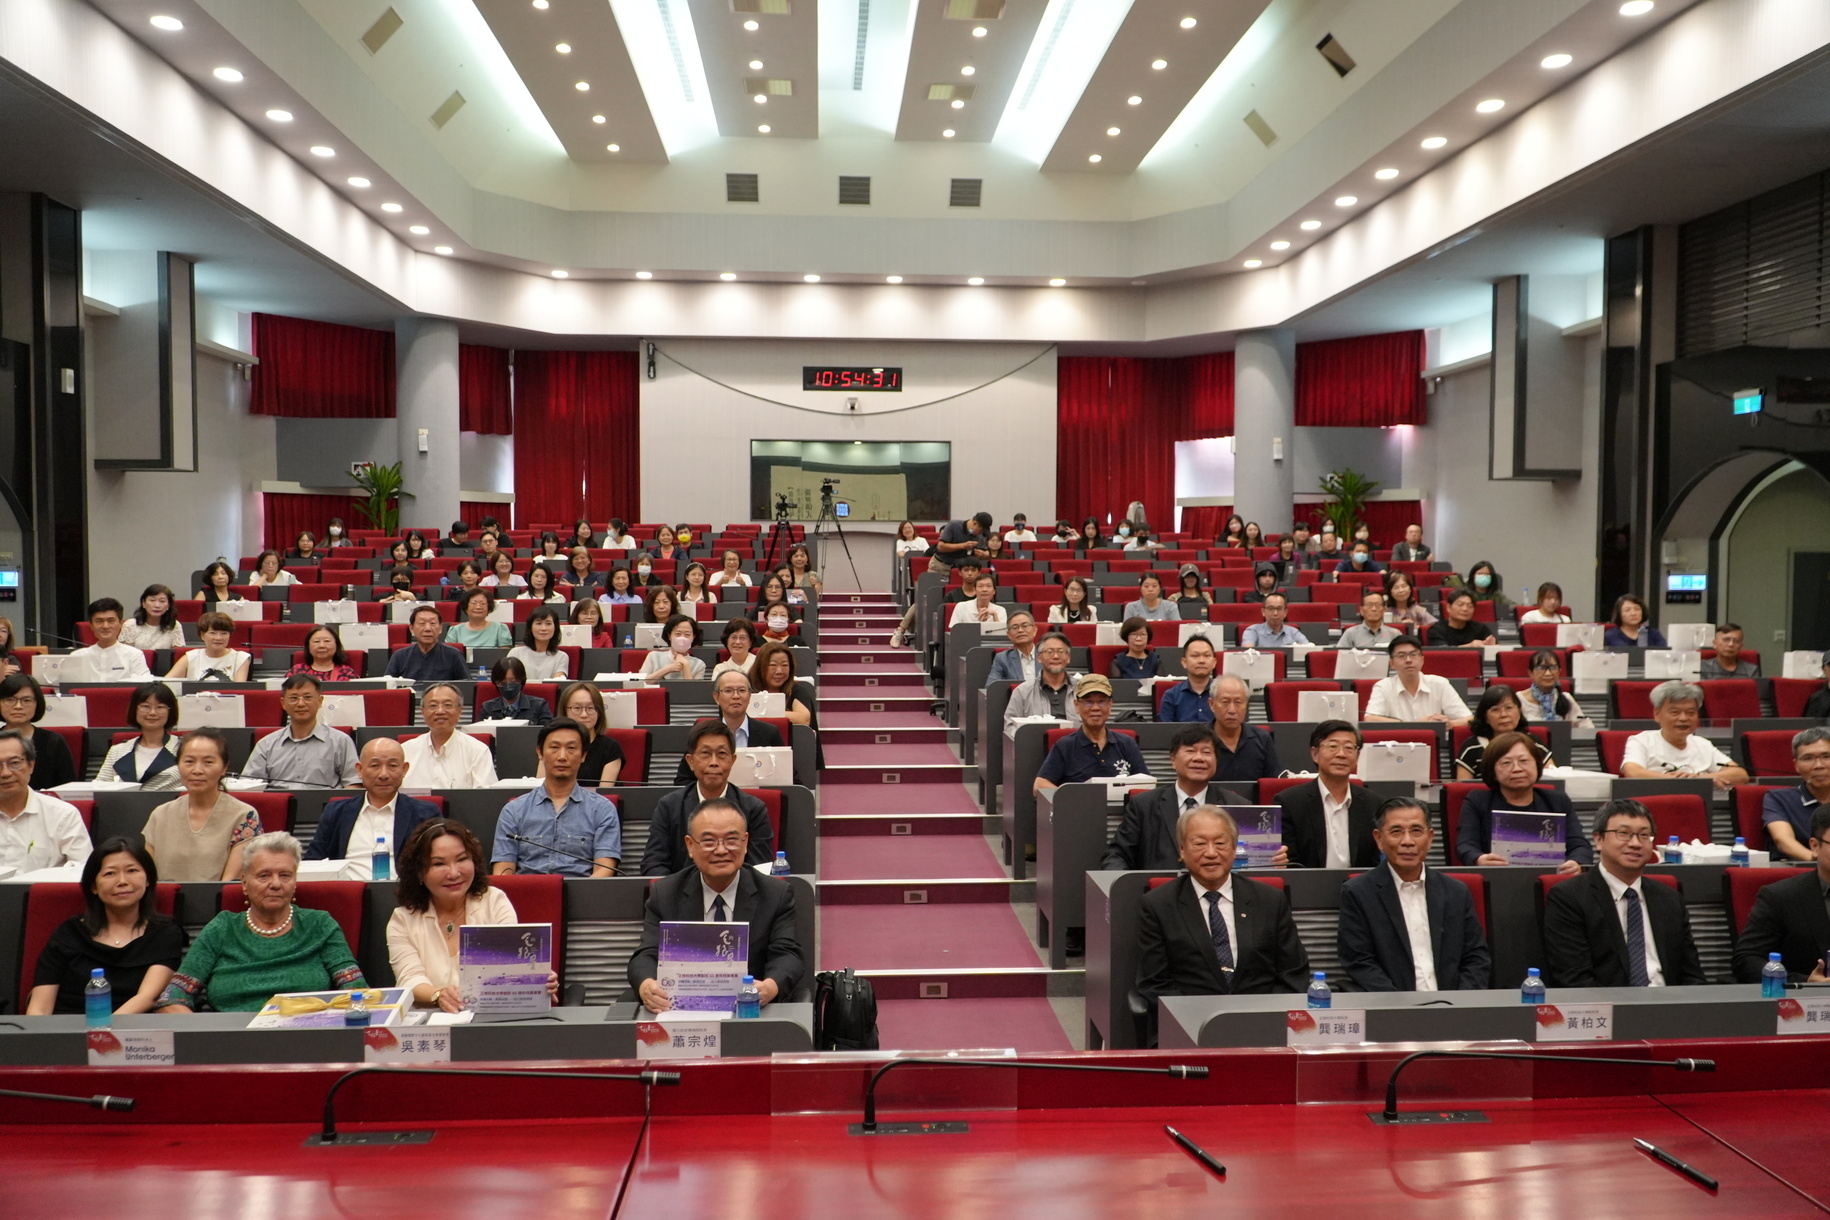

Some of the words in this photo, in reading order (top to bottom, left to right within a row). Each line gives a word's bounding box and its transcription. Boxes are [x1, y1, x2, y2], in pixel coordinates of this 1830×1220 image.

[815, 371, 898, 388] 10:54:31
[1319, 1022, 1360, 1035] 龔瑞璋
[1567, 1016, 1607, 1029] 黃柏文
[401, 1039, 447, 1053] 吳素琴
[672, 1034, 717, 1048] 蕭宗煌
